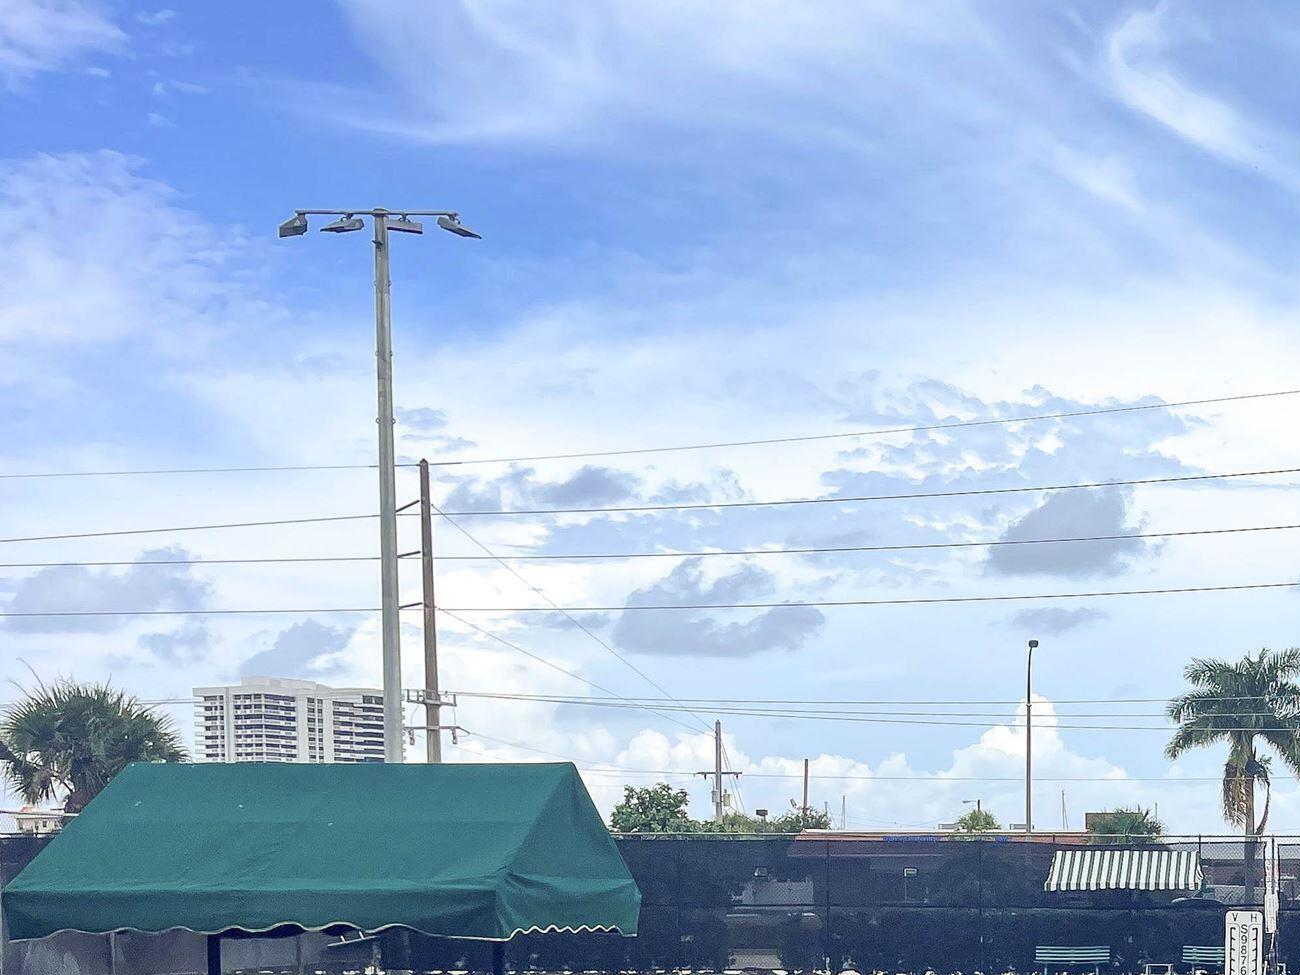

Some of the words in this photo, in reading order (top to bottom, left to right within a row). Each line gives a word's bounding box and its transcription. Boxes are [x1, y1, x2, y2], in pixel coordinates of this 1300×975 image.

[1232, 913, 1239, 922] V
[1250, 913, 1258, 922] H
[1240, 924, 1248, 934] S
[1240, 935, 1248, 944] 9
[1240, 945, 1247, 955] 8
[1240, 956, 1247, 965] 7
[1240, 966, 1247, 975] 6
